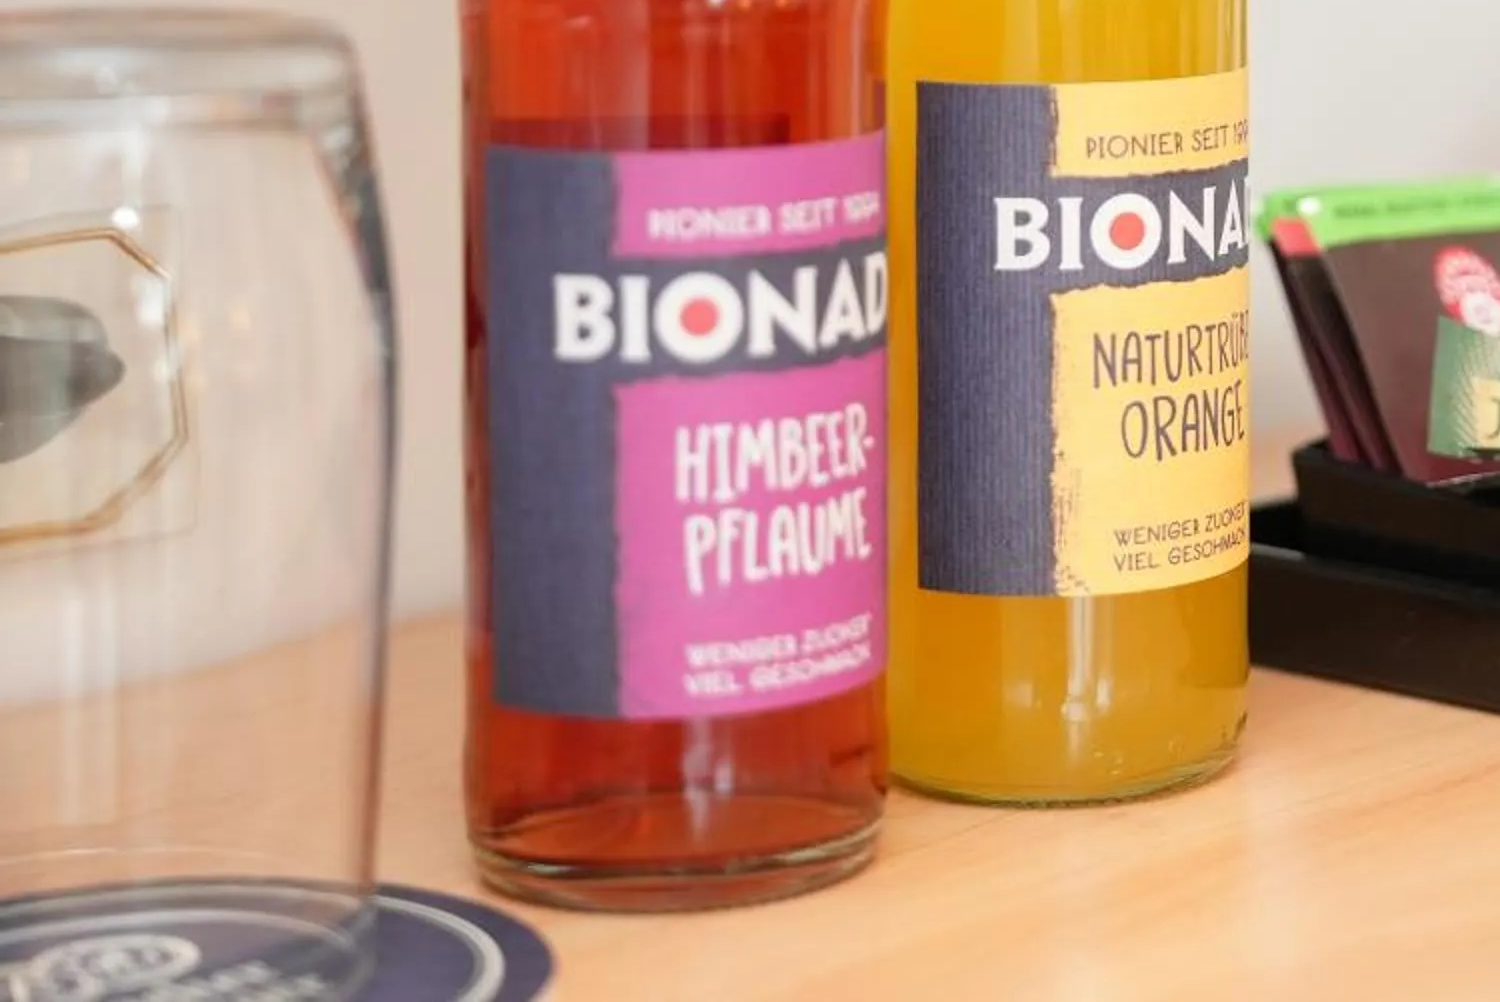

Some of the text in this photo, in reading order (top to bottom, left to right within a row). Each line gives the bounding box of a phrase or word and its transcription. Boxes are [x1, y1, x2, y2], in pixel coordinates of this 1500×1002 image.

[1086, 131, 1183, 159] PIONIER
[1191, 124, 1229, 152] SEIT
[647, 204, 771, 241] PIONIER
[778, 197, 838, 235] SEIT
[1121, 379, 1245, 462] ORANGE
[674, 402, 874, 505] HIMBEER-
[683, 487, 872, 596] PFLAUME
[1113, 518, 1200, 547] WENIGER
[1113, 551, 1160, 572] VIEL
